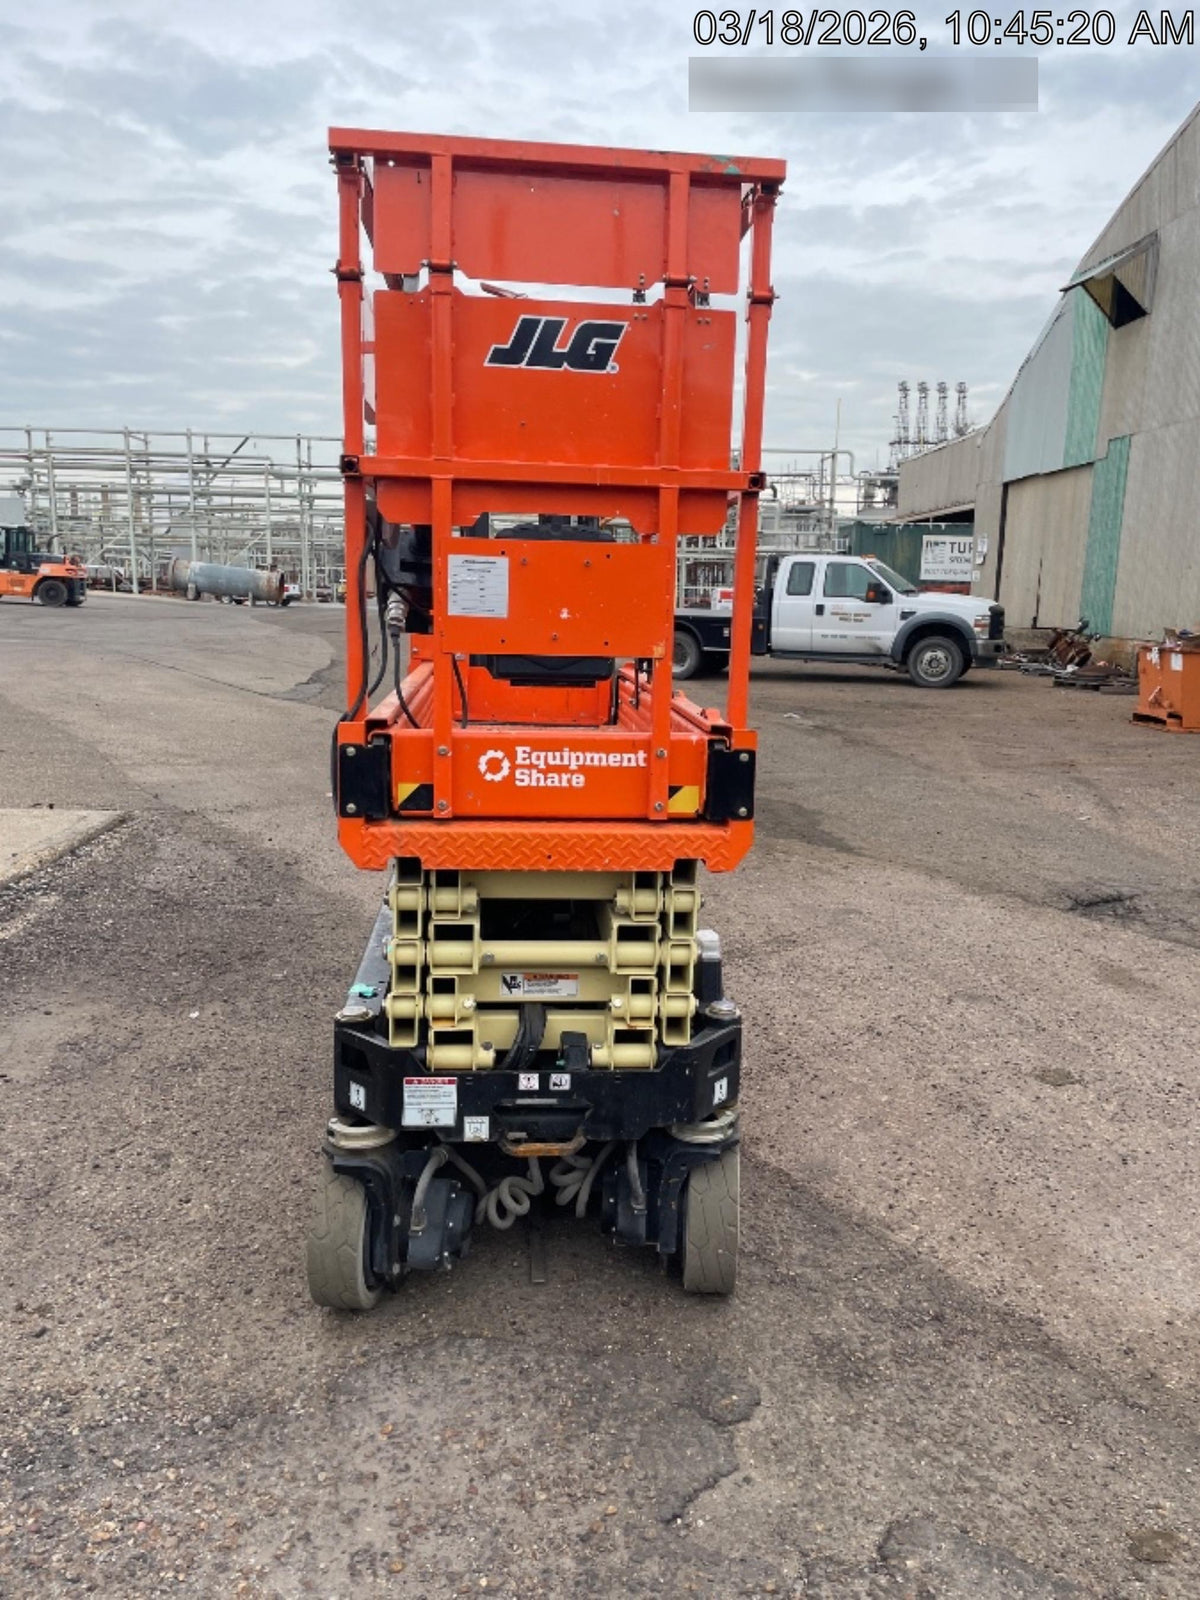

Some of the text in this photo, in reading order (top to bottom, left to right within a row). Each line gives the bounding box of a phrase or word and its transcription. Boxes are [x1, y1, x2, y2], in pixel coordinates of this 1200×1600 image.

[483, 314, 630, 374] JLG
[514, 746, 648, 770] Equipment
[514, 768, 586, 788] Share
